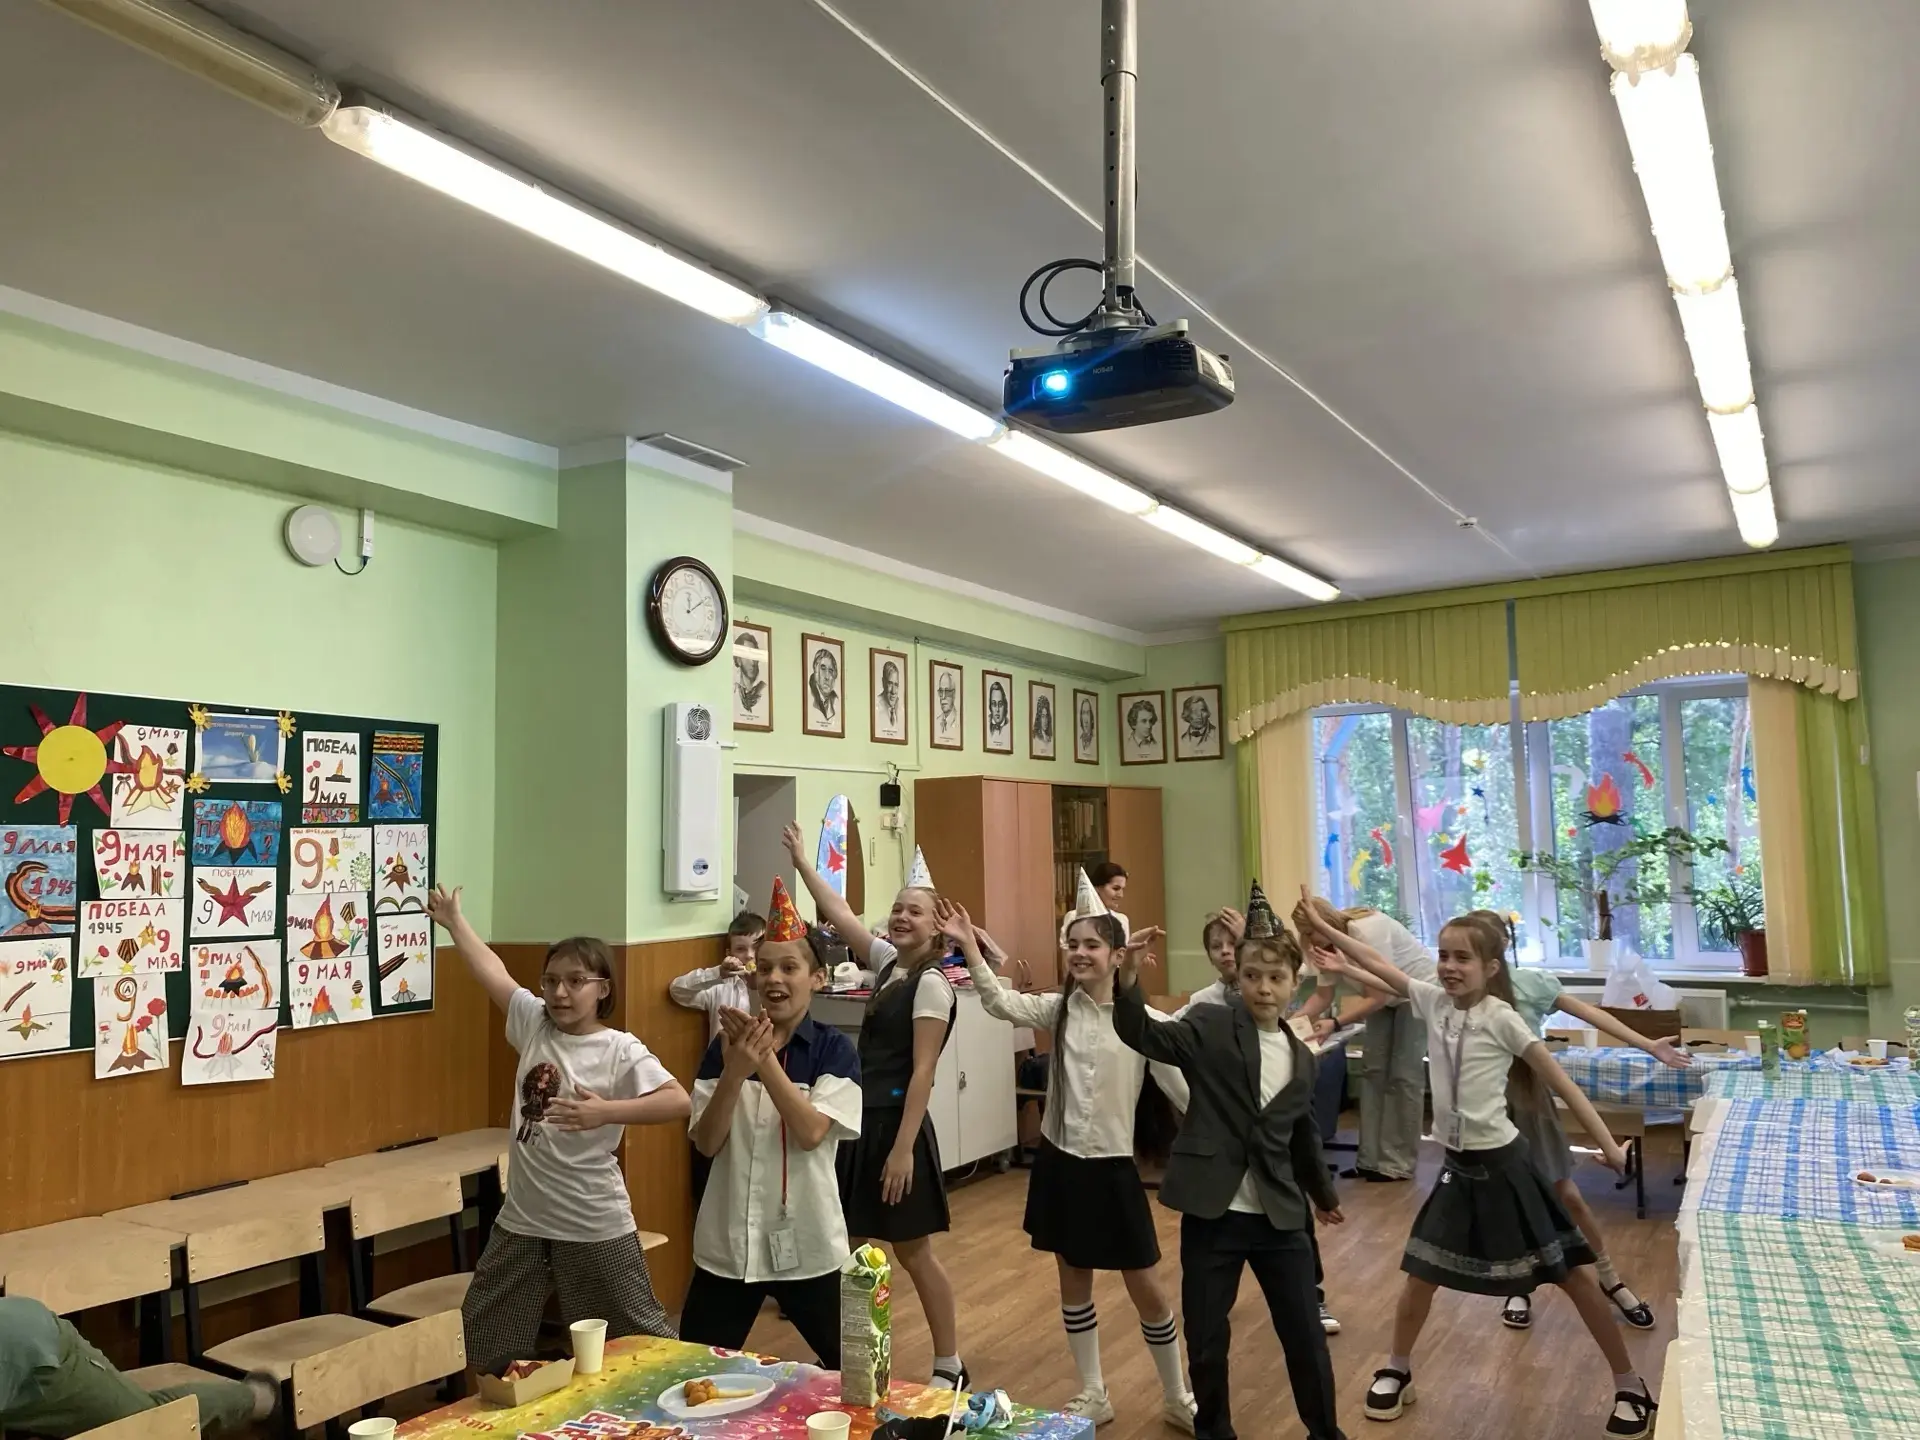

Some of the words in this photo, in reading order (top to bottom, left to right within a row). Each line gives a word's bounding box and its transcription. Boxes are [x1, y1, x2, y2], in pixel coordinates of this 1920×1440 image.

[306, 738, 357, 755] ПОБЕДА
[307, 776, 320, 806] 9
[320, 791, 348, 805] МАЯ
[4, 831, 18, 854] 9
[18, 839, 76, 854] МАЯ
[102, 831, 121, 866] 9
[385, 830, 394, 845] 9
[397, 830, 427, 847] МАЯ
[295, 838, 324, 889] 9
[323, 879, 357, 893] МАЯ
[29, 877, 76, 896] 1945
[88, 902, 166, 920] ПОБЕДА
[197, 900, 213, 925] 9
[251, 909, 273, 923] МАЯ
[88, 922, 123, 935] 1945
[157, 929, 170, 953] 9
[384, 934, 393, 949] 9
[396, 931, 427, 948] МАЯ
[14, 961, 25, 975] 9
[27, 959, 47, 972] МАЯ
[147, 953, 180, 969] МАЯ
[197, 946, 210, 968] 9
[298, 964, 310, 985] 9
[316, 961, 352, 980] МАЯ
[210, 1013, 226, 1038] 9
